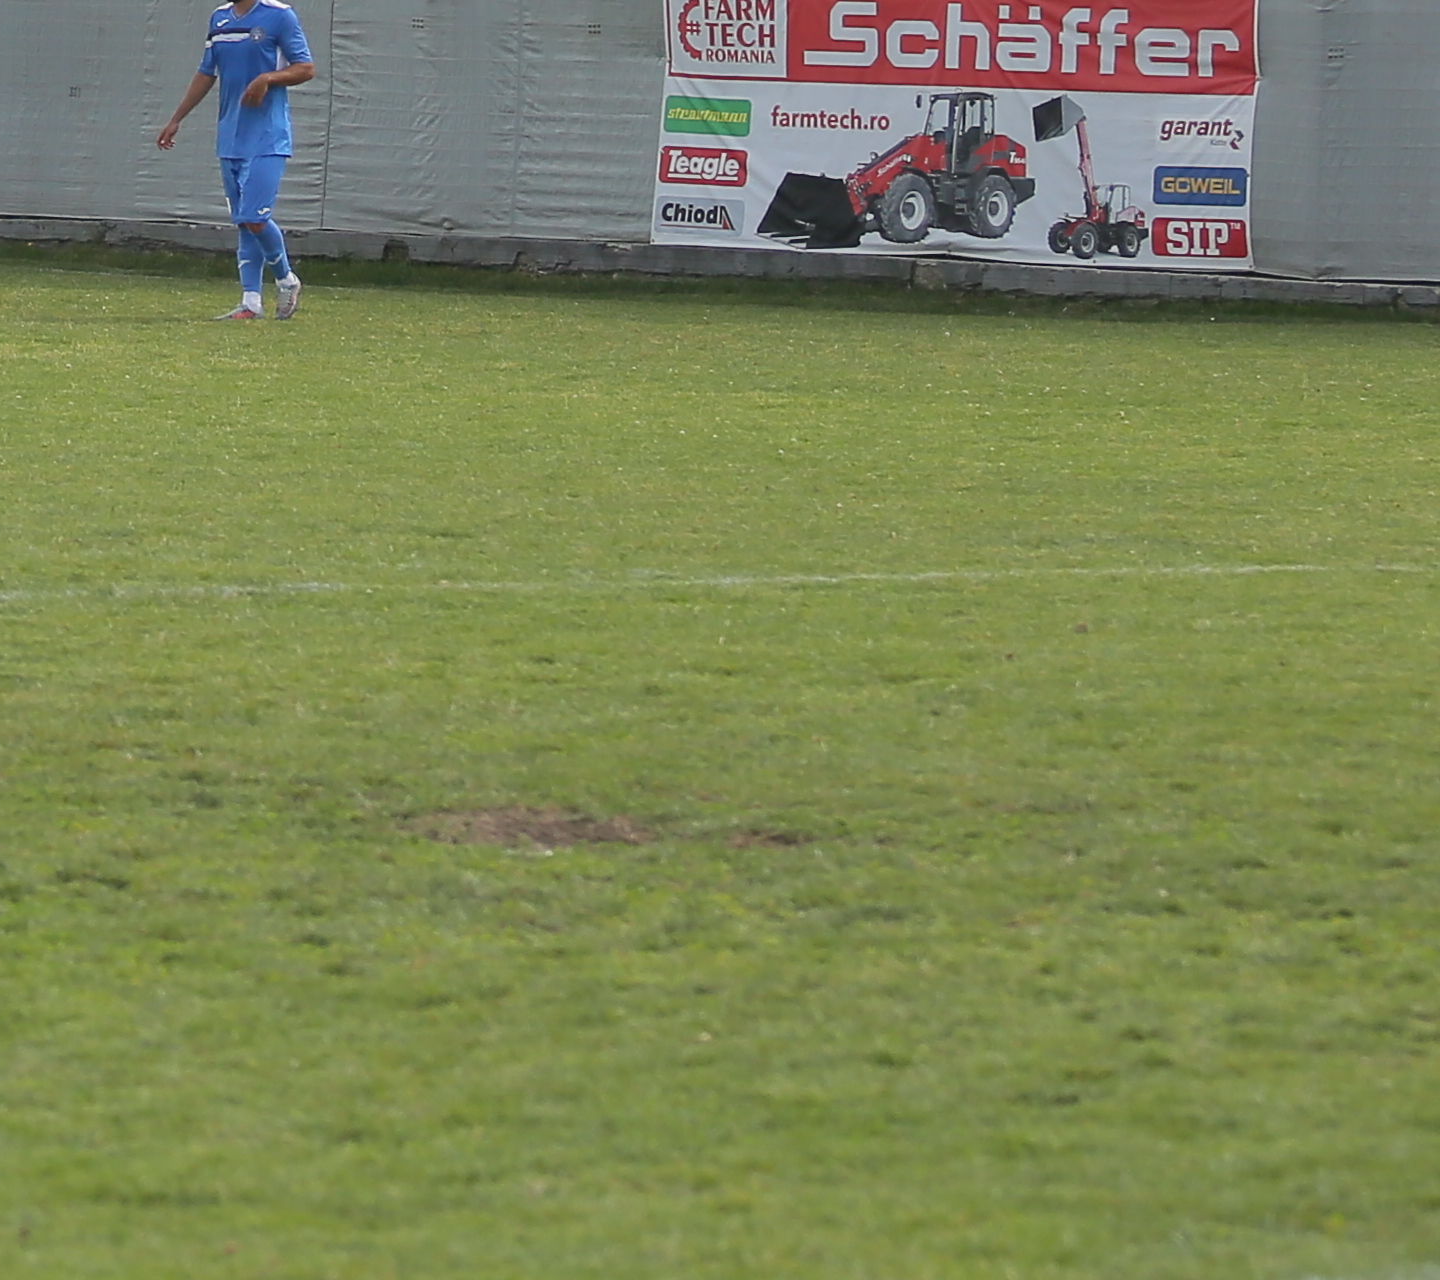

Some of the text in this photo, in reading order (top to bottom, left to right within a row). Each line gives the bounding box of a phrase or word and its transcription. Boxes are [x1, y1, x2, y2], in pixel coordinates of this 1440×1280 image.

[704, 22, 776, 48] TECH
[804, 0, 1241, 77] Schäffer
[705, 48, 776, 64] ROMANIA
[770, 105, 890, 131] farmtech.ro
[1160, 118, 1234, 141] garant
[668, 149, 740, 181] Teagle
[1166, 221, 1230, 256] SIP
